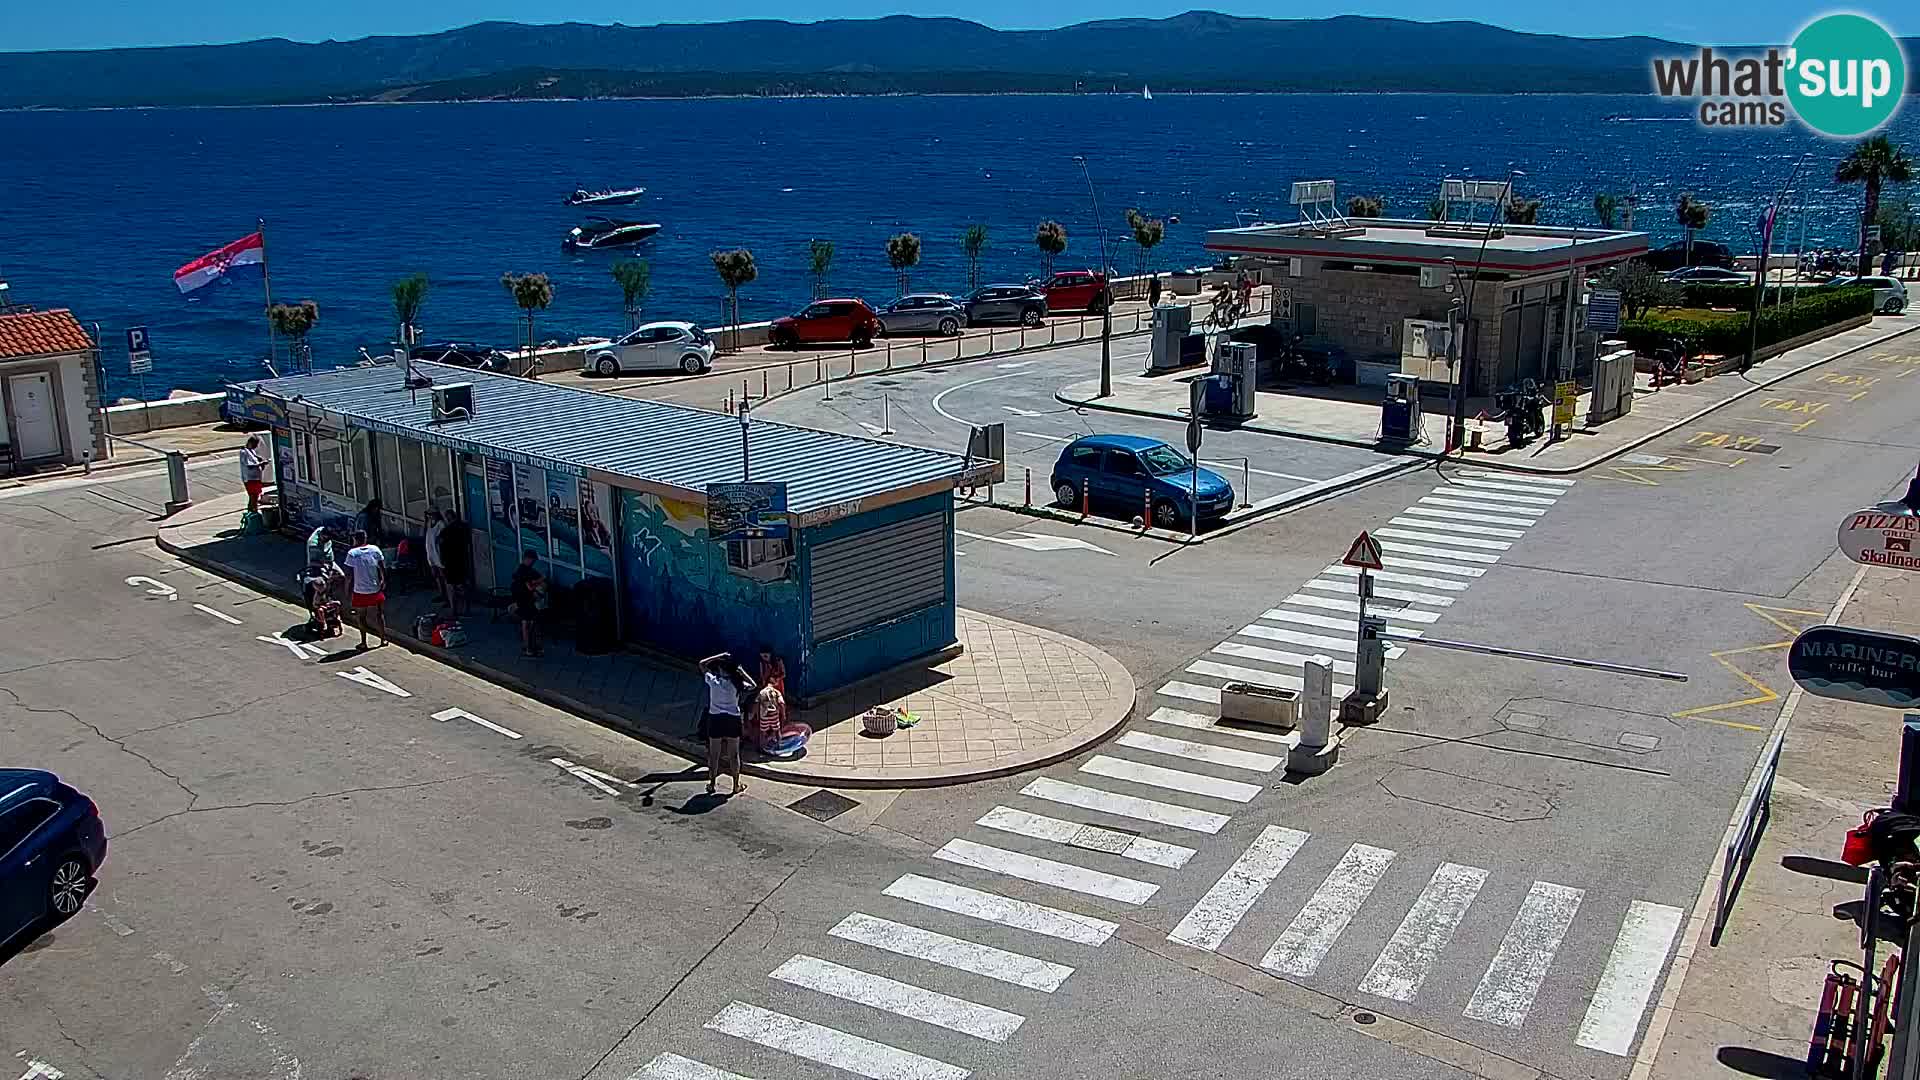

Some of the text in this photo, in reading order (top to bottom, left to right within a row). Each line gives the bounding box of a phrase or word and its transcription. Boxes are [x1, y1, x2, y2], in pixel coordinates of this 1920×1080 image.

[131, 330, 143, 349] P
[1760, 398, 1832, 414] TAXI
[1687, 432, 1764, 451] TAXI
[437, 437, 470, 450] POSTAJA
[479, 445, 493, 457] BUS
[495, 449, 527, 465] STATION
[528, 456, 555, 470] TICKET
[556, 462, 583, 476] OFFICE
[1848, 514, 1920, 532] PIZZE
[1882, 530, 1916, 539] GRILL
[1829, 662, 1897, 679] caffe bar
